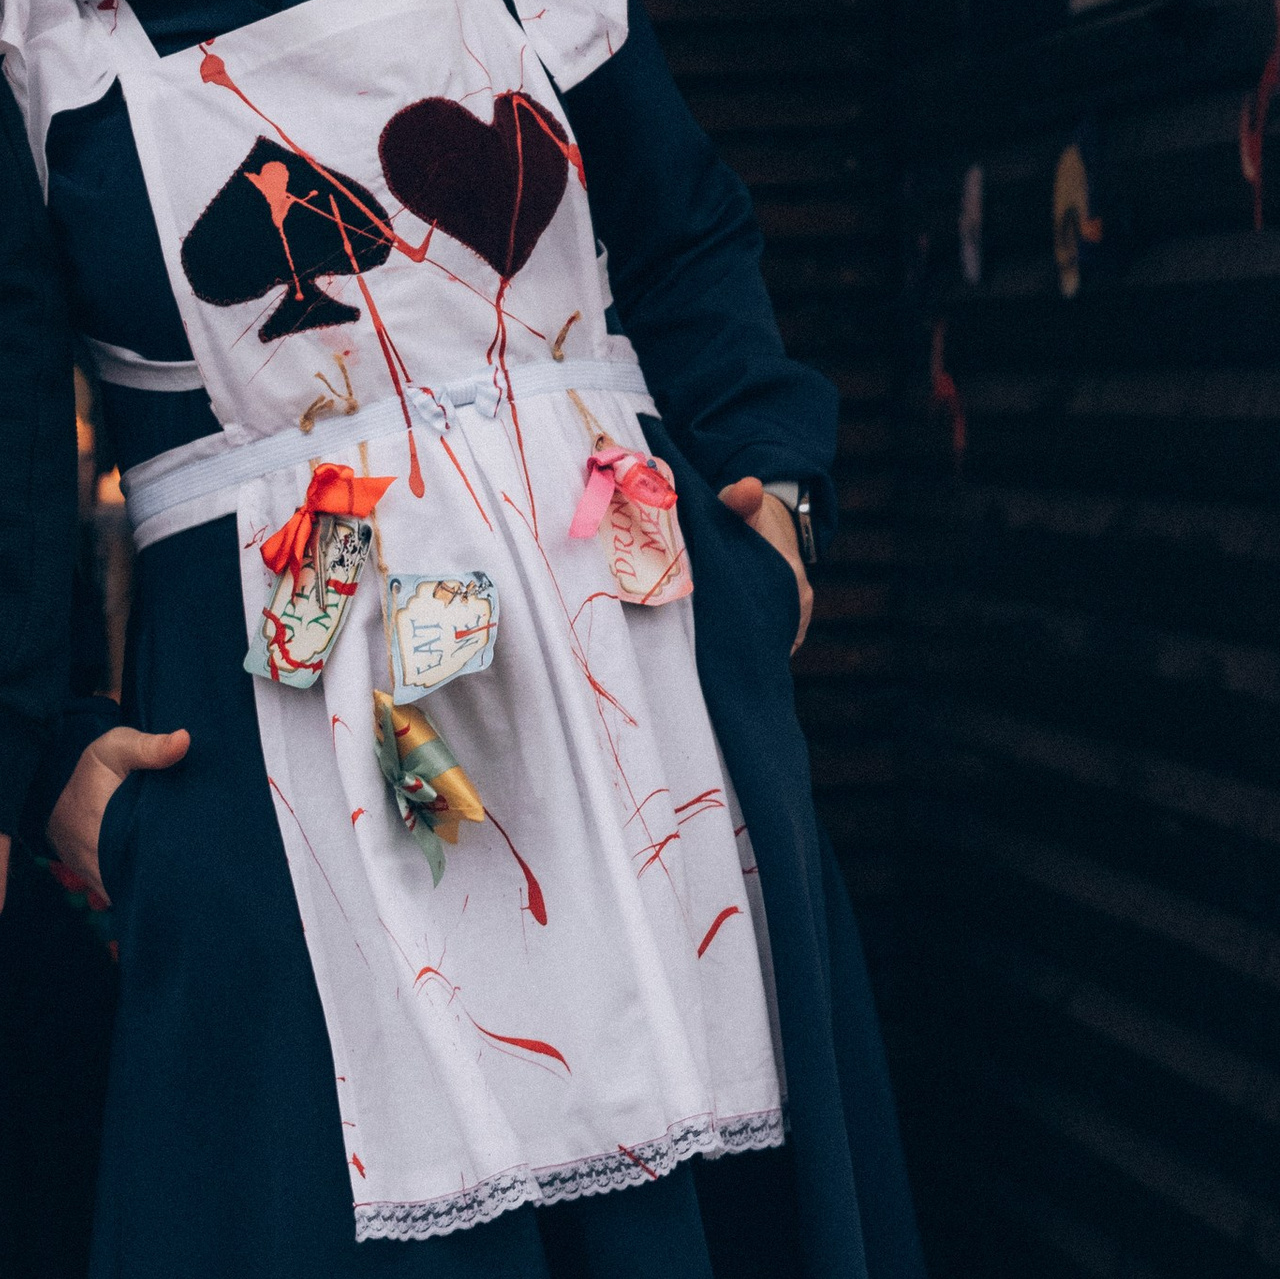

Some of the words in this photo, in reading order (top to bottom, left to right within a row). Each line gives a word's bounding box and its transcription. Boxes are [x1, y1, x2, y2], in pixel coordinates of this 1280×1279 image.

[609, 488, 638, 581] DRIN
[639, 507, 667, 555] ME
[410, 618, 444, 675] EAT
